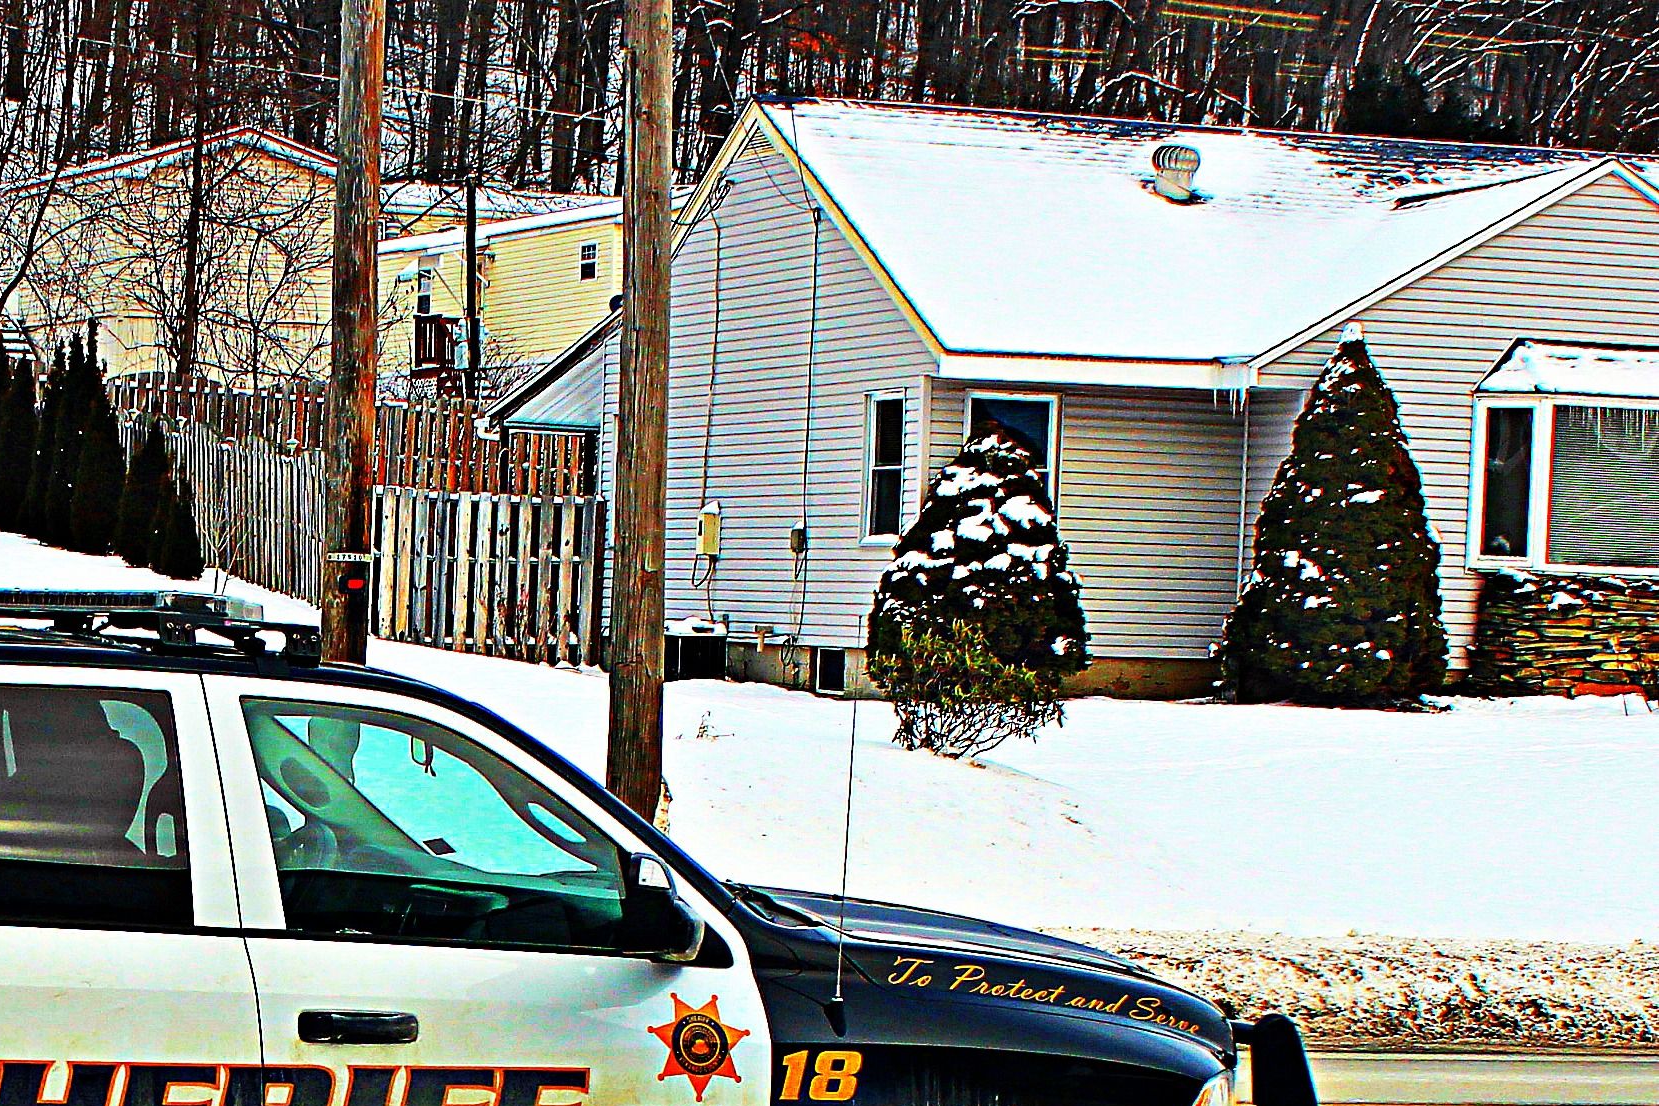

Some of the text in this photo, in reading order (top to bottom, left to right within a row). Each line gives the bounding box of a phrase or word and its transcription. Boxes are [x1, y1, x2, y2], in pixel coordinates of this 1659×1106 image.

[888, 956, 1200, 1034] To Protect and Serve
[778, 1050, 863, 1101] 18
